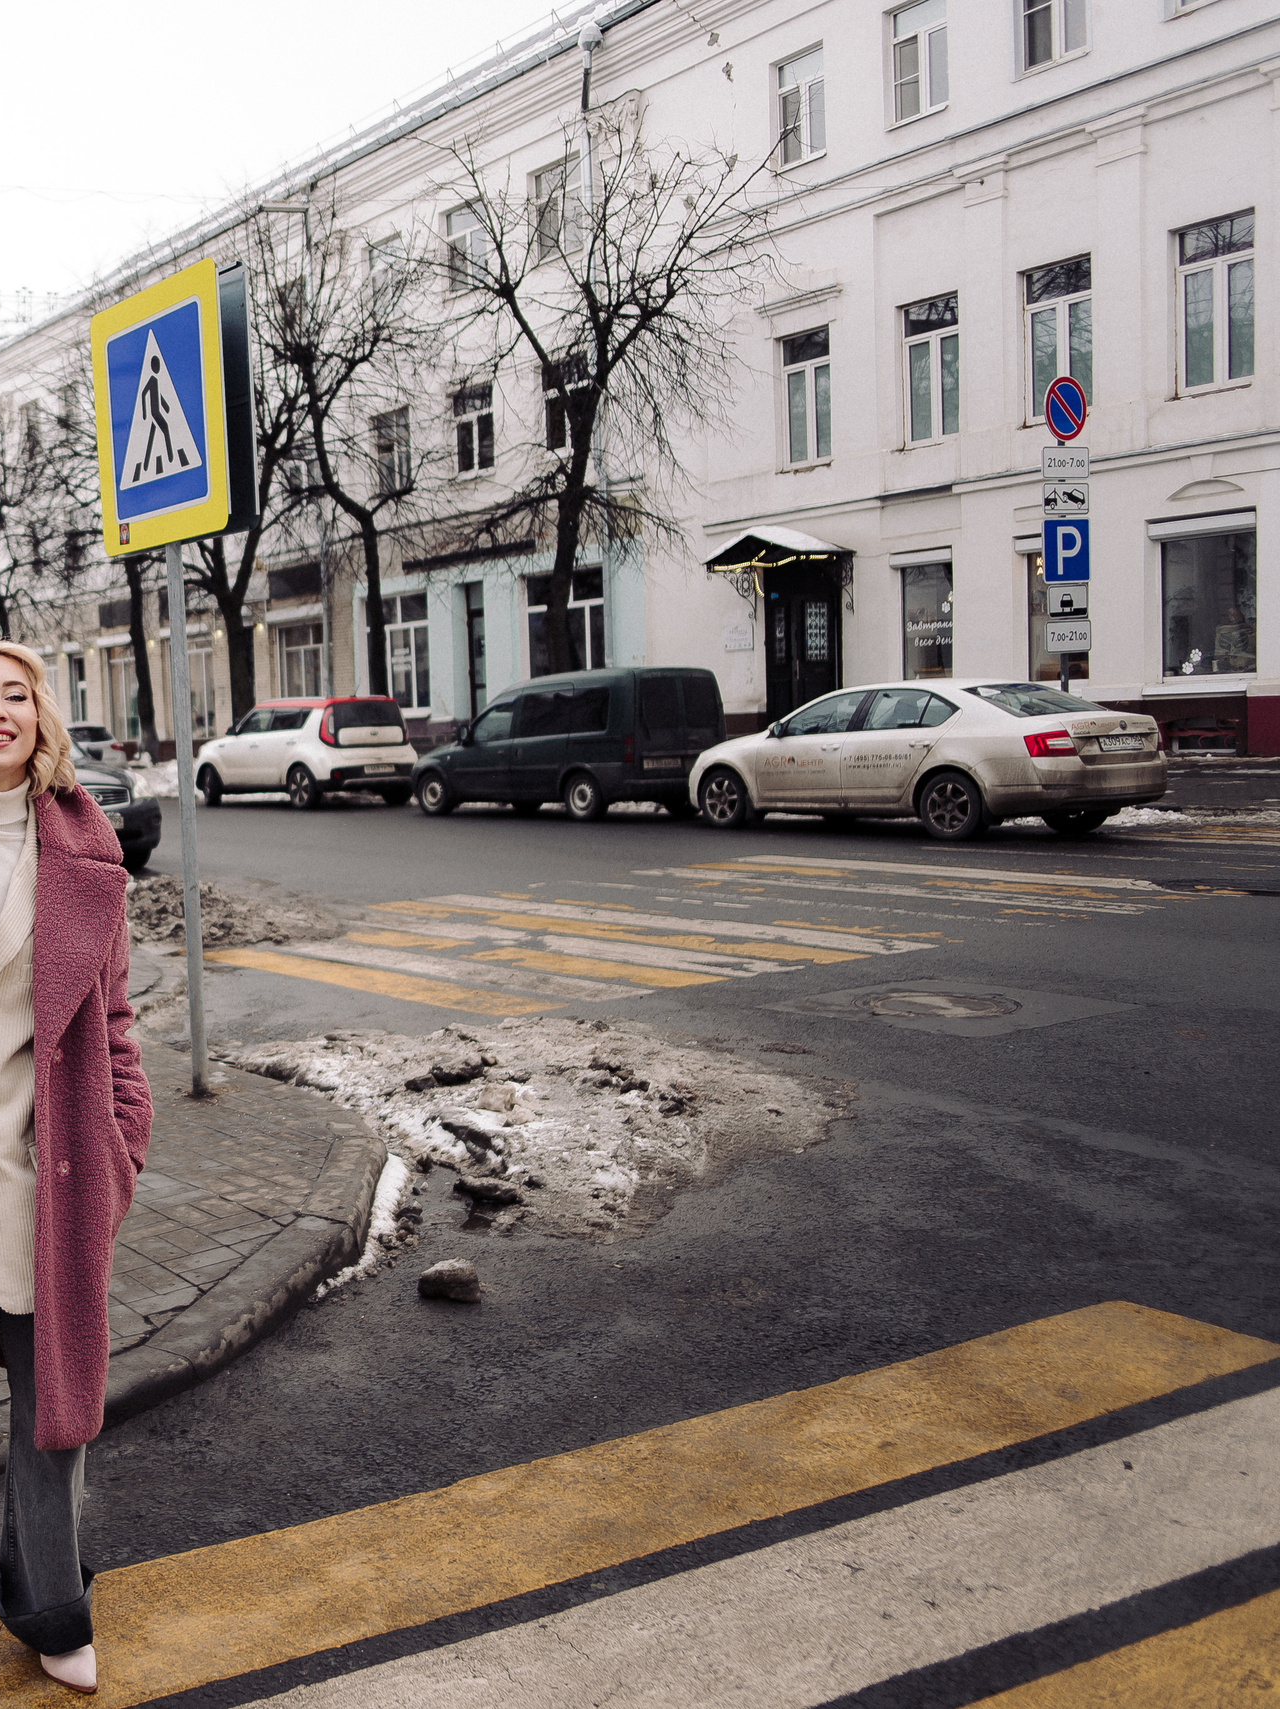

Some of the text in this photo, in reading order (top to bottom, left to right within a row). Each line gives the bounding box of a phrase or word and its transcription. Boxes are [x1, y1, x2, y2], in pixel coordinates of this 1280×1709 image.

[1047, 457, 1085, 468] 21.00-7.00
[1057, 526, 1082, 575] P
[914, 634, 953, 647] весь ден
[1050, 630, 1088, 642] 7.00-21.00
